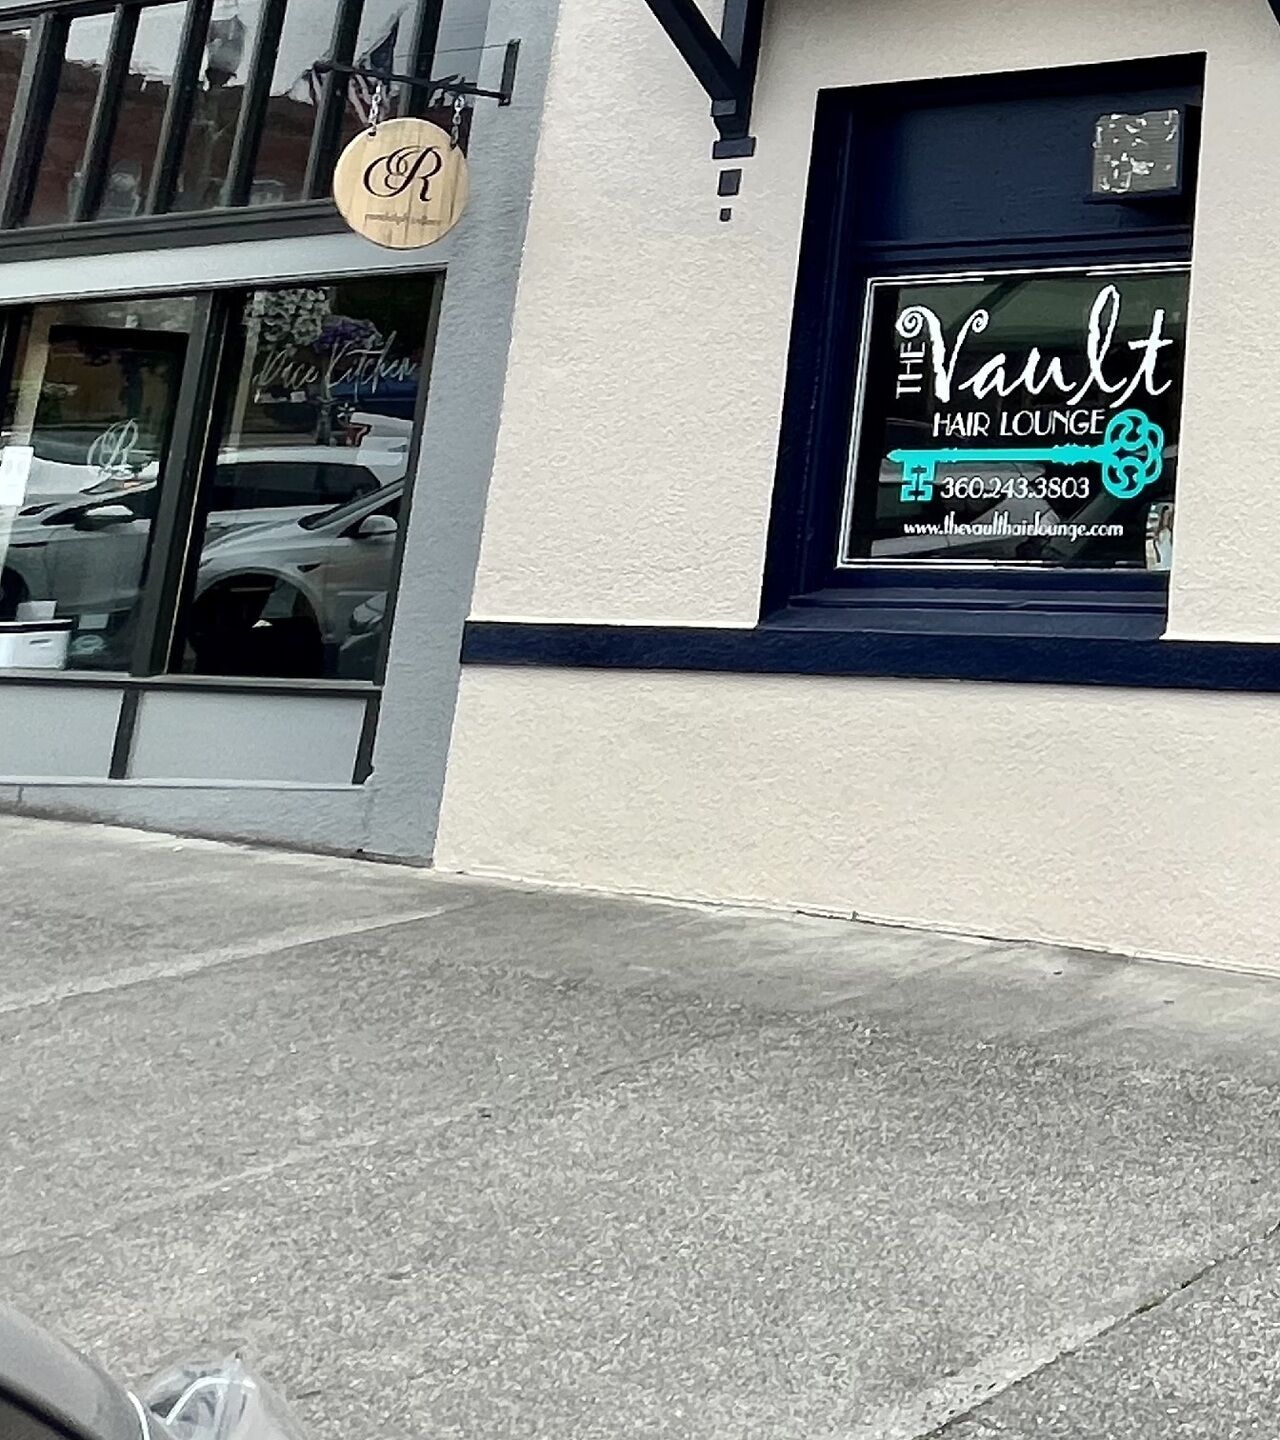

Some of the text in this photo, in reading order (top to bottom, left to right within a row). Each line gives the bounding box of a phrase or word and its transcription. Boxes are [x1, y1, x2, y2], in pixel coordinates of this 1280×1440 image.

[896, 283, 1174, 409] Vault
[896, 341, 926, 399] THE
[933, 408, 1107, 437] HAIR LOUNGE
[940, 476, 1091, 499] 360.243.3803
[903, 511, 1125, 542] www.thevaulthairlounge.com
